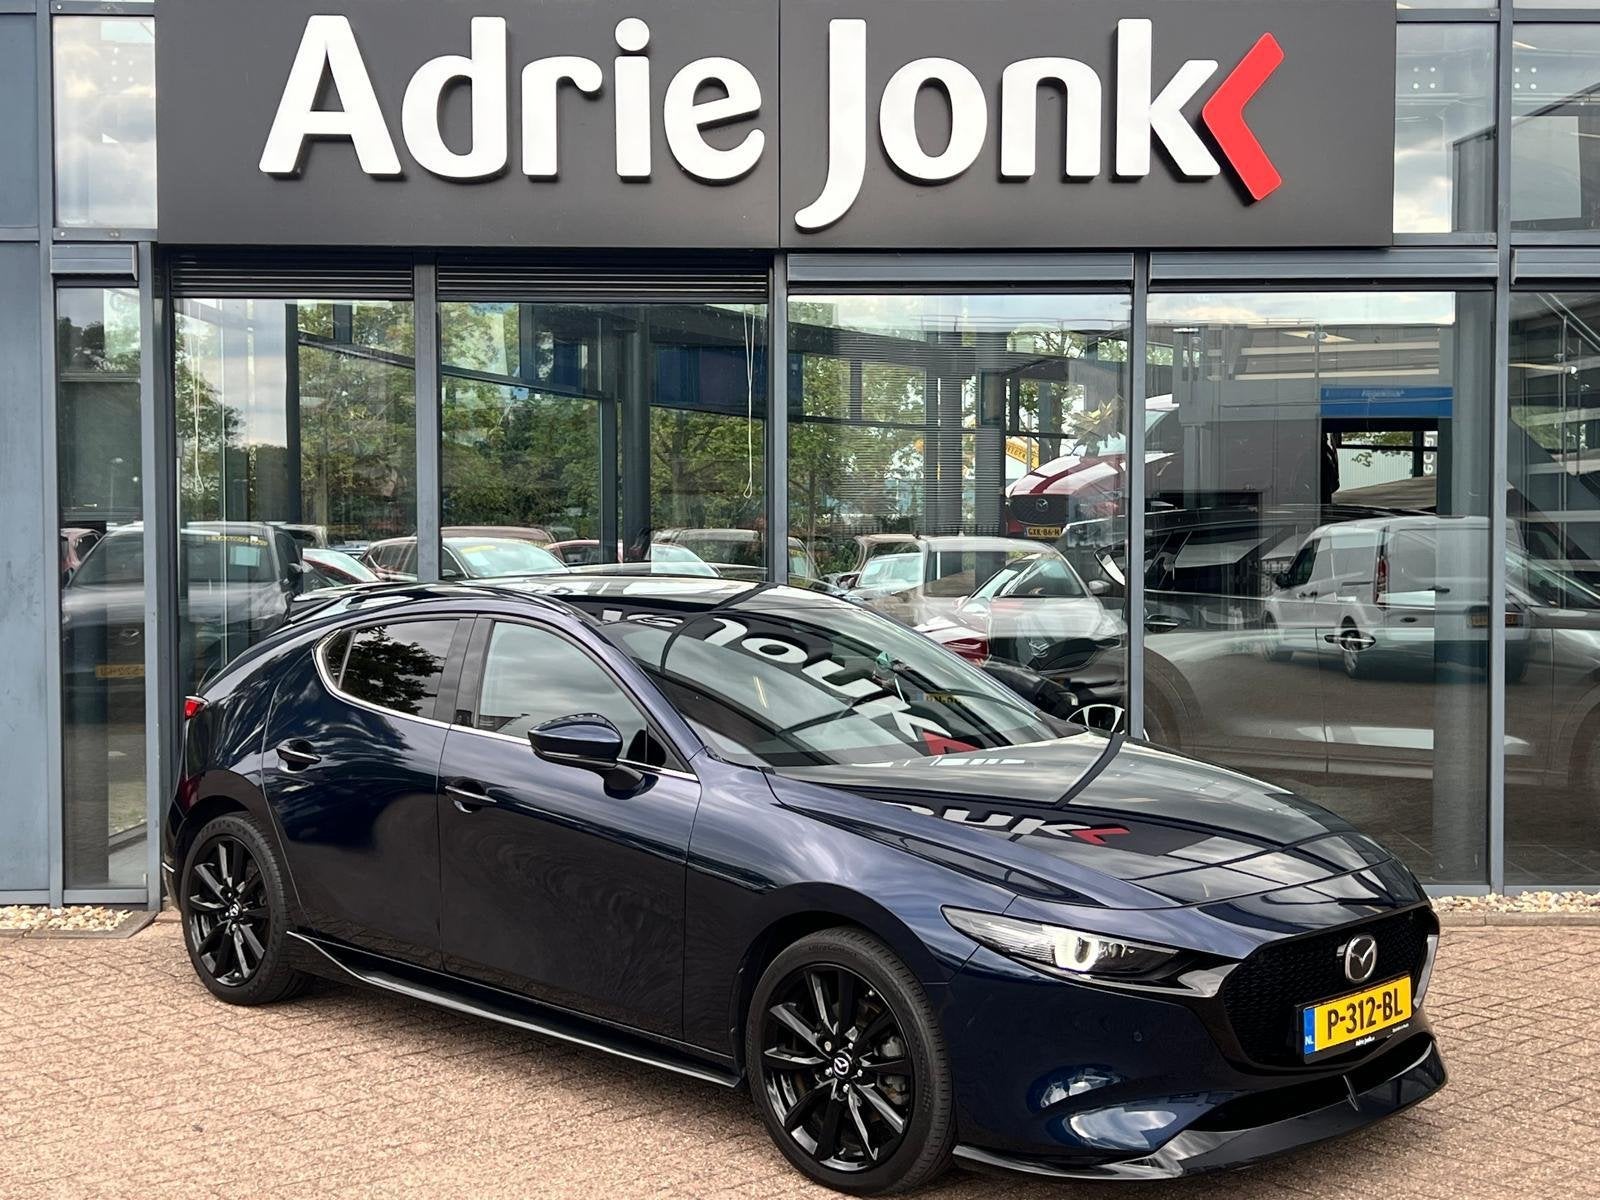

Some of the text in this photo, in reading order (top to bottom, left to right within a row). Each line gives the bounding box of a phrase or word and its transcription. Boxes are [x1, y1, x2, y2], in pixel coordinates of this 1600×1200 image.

[259, 14, 1223, 230] Adrie Jonk
[1328, 988, 1403, 1040] P-312-BL
[1305, 1037, 1314, 1046] NL
